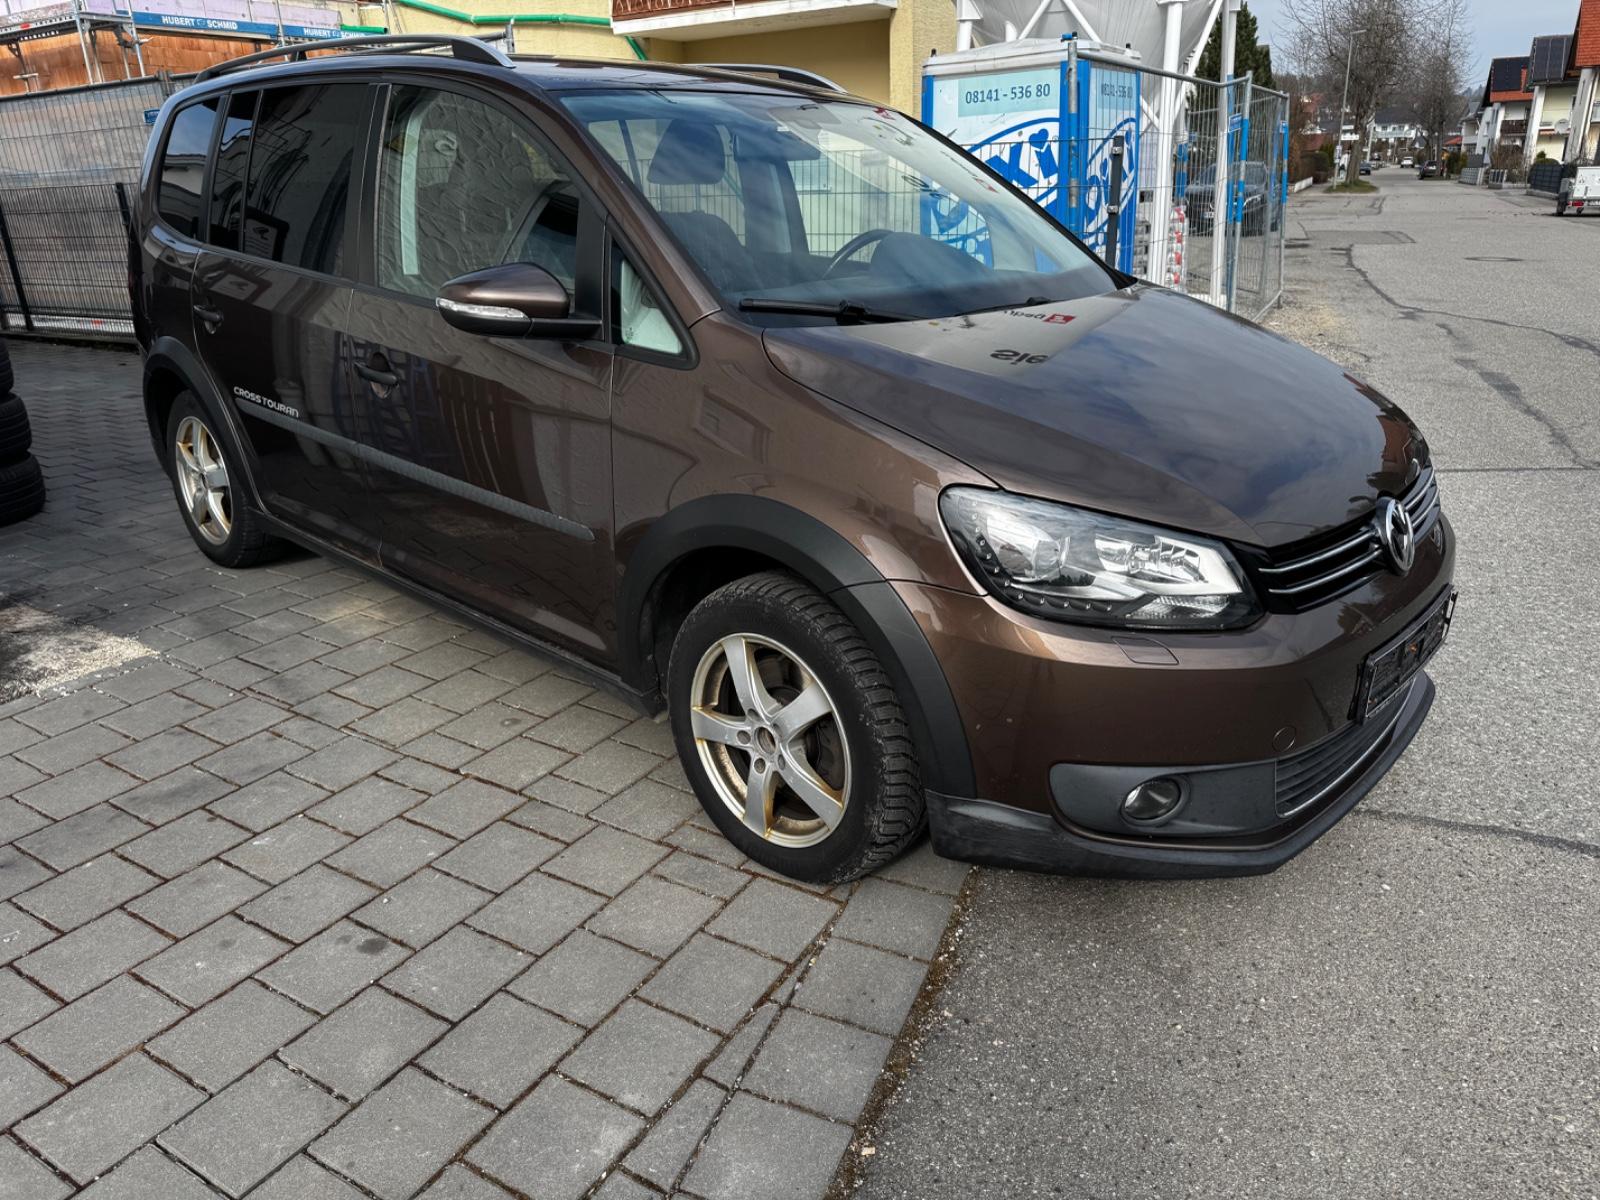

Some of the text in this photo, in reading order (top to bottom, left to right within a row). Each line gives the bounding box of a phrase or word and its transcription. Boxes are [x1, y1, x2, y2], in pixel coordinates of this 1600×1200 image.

[162, 16, 238, 30] HUBERT SCHMID
[965, 88, 1000, 104] 08141
[1010, 85, 1032, 101] 536
[1035, 83, 1050, 99] 80
[233, 386, 299, 418] CROSS TOURAN
